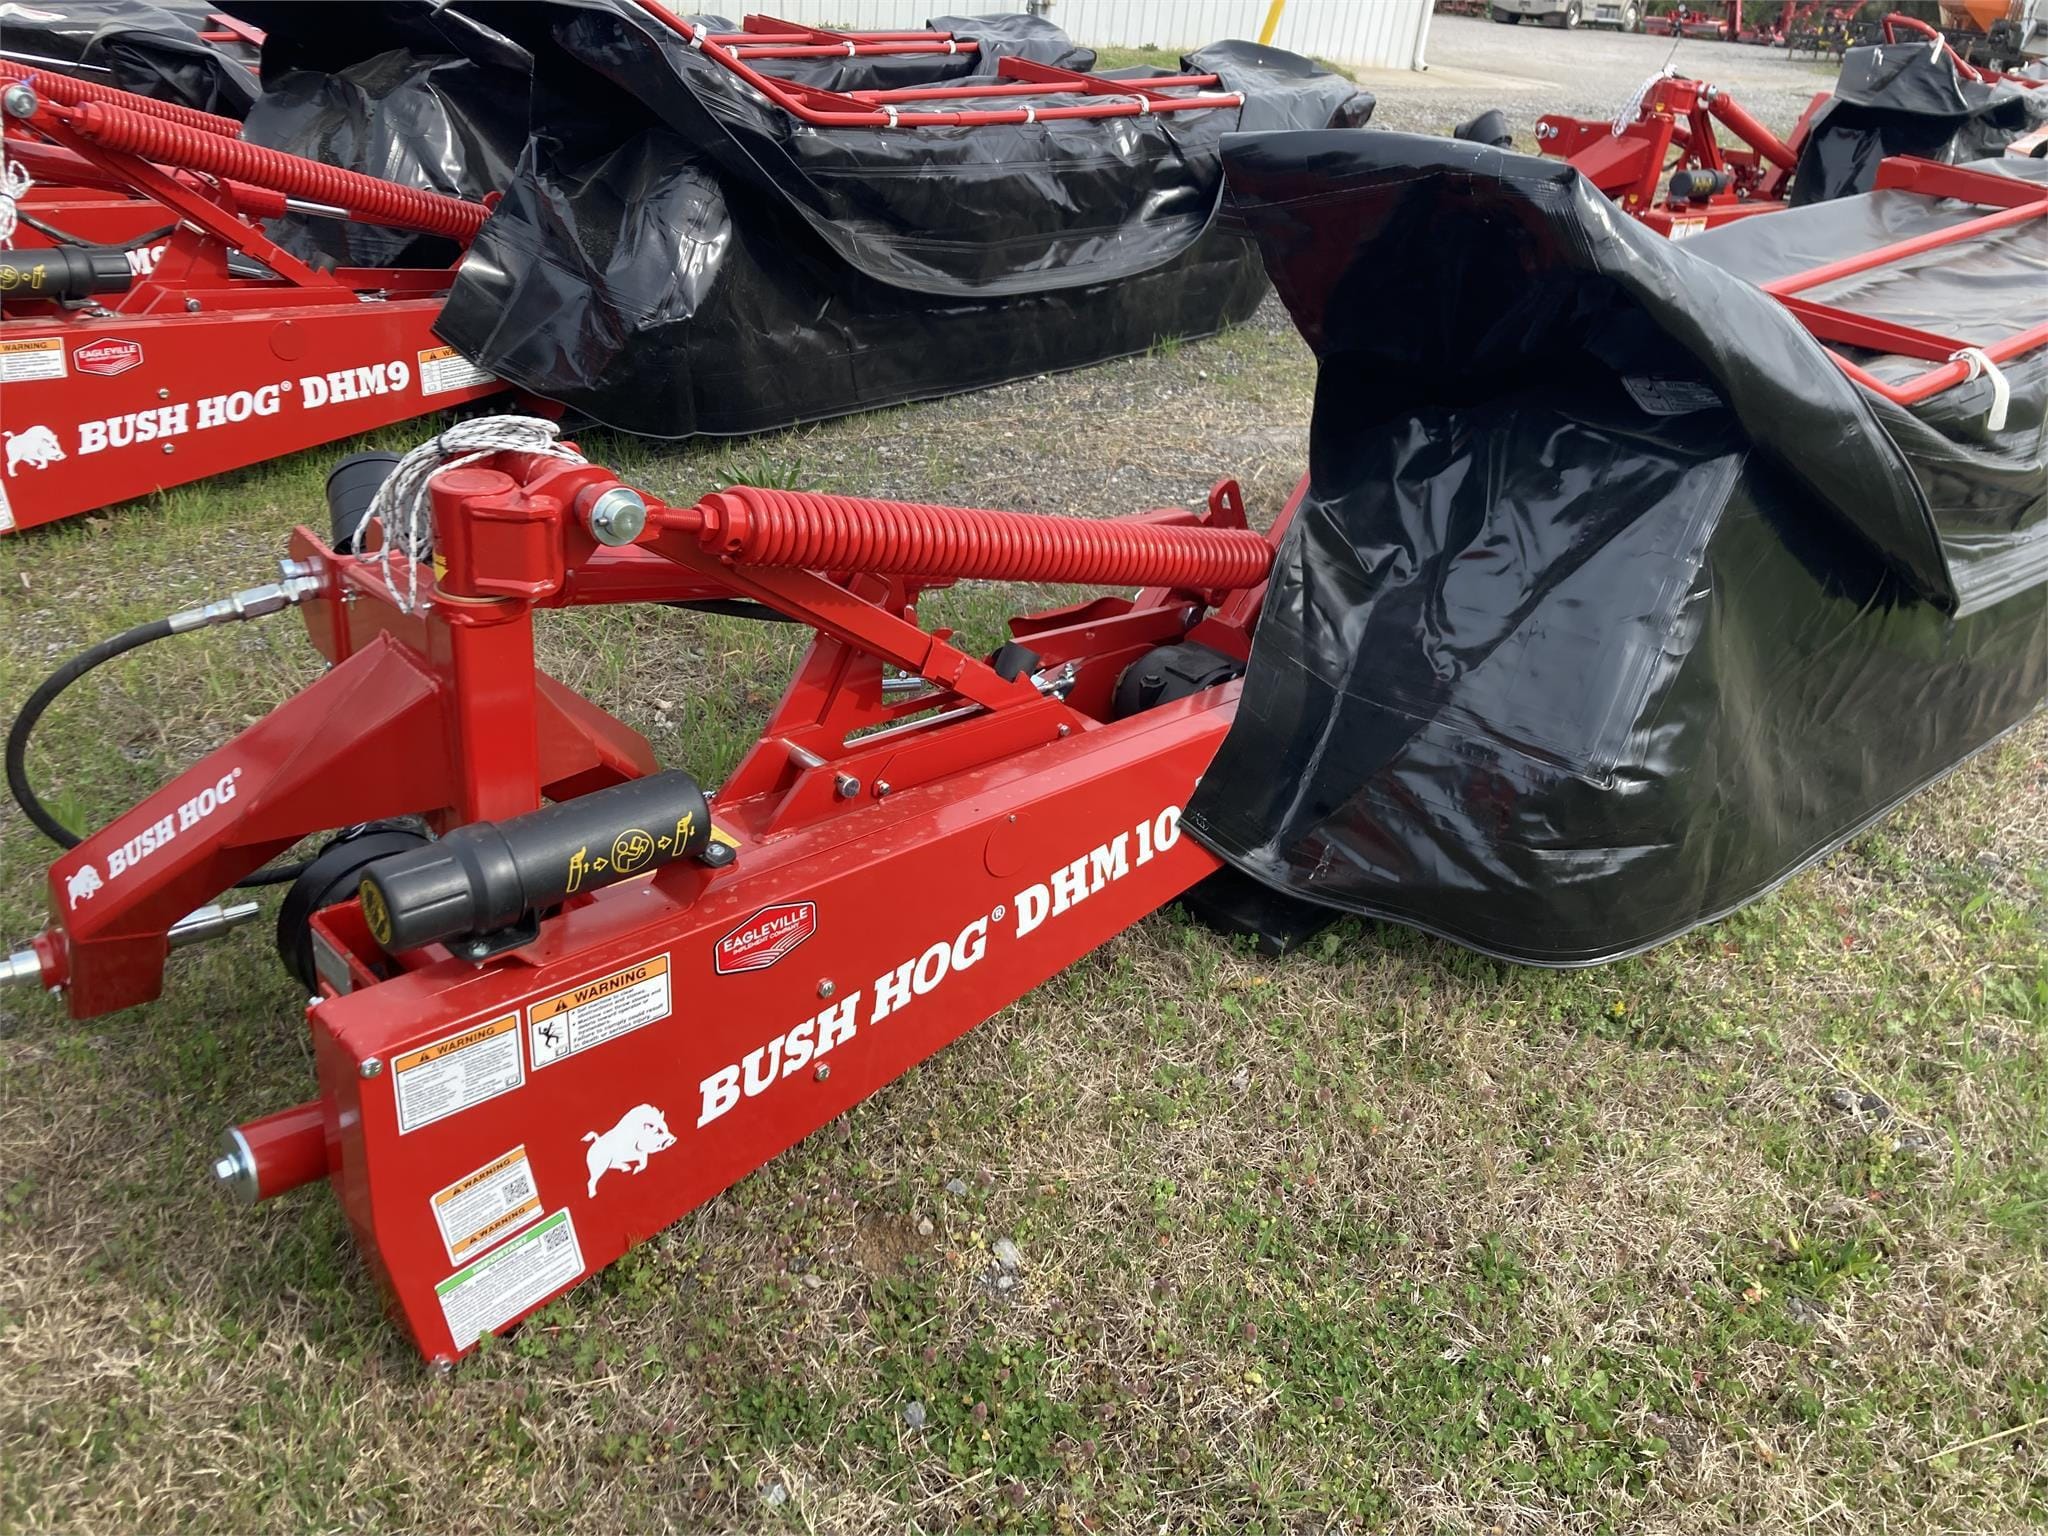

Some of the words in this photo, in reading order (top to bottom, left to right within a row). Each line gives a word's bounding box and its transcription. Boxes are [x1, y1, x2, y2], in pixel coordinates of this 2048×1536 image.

[2, 341, 48, 351] WARNING
[78, 344, 138, 359] EAGLEVILLE
[77, 403, 189, 455] BUSH
[299, 360, 410, 410] DHM9
[107, 813, 176, 880] BUSH
[723, 906, 808, 953] EAGLEVILLE
[574, 967, 647, 1003] WARNING
[437, 1026, 495, 1055] WARNING
[697, 991, 861, 1129] BUSH
[463, 1158, 511, 1189] WARNING
[480, 1207, 526, 1238] WARNING
